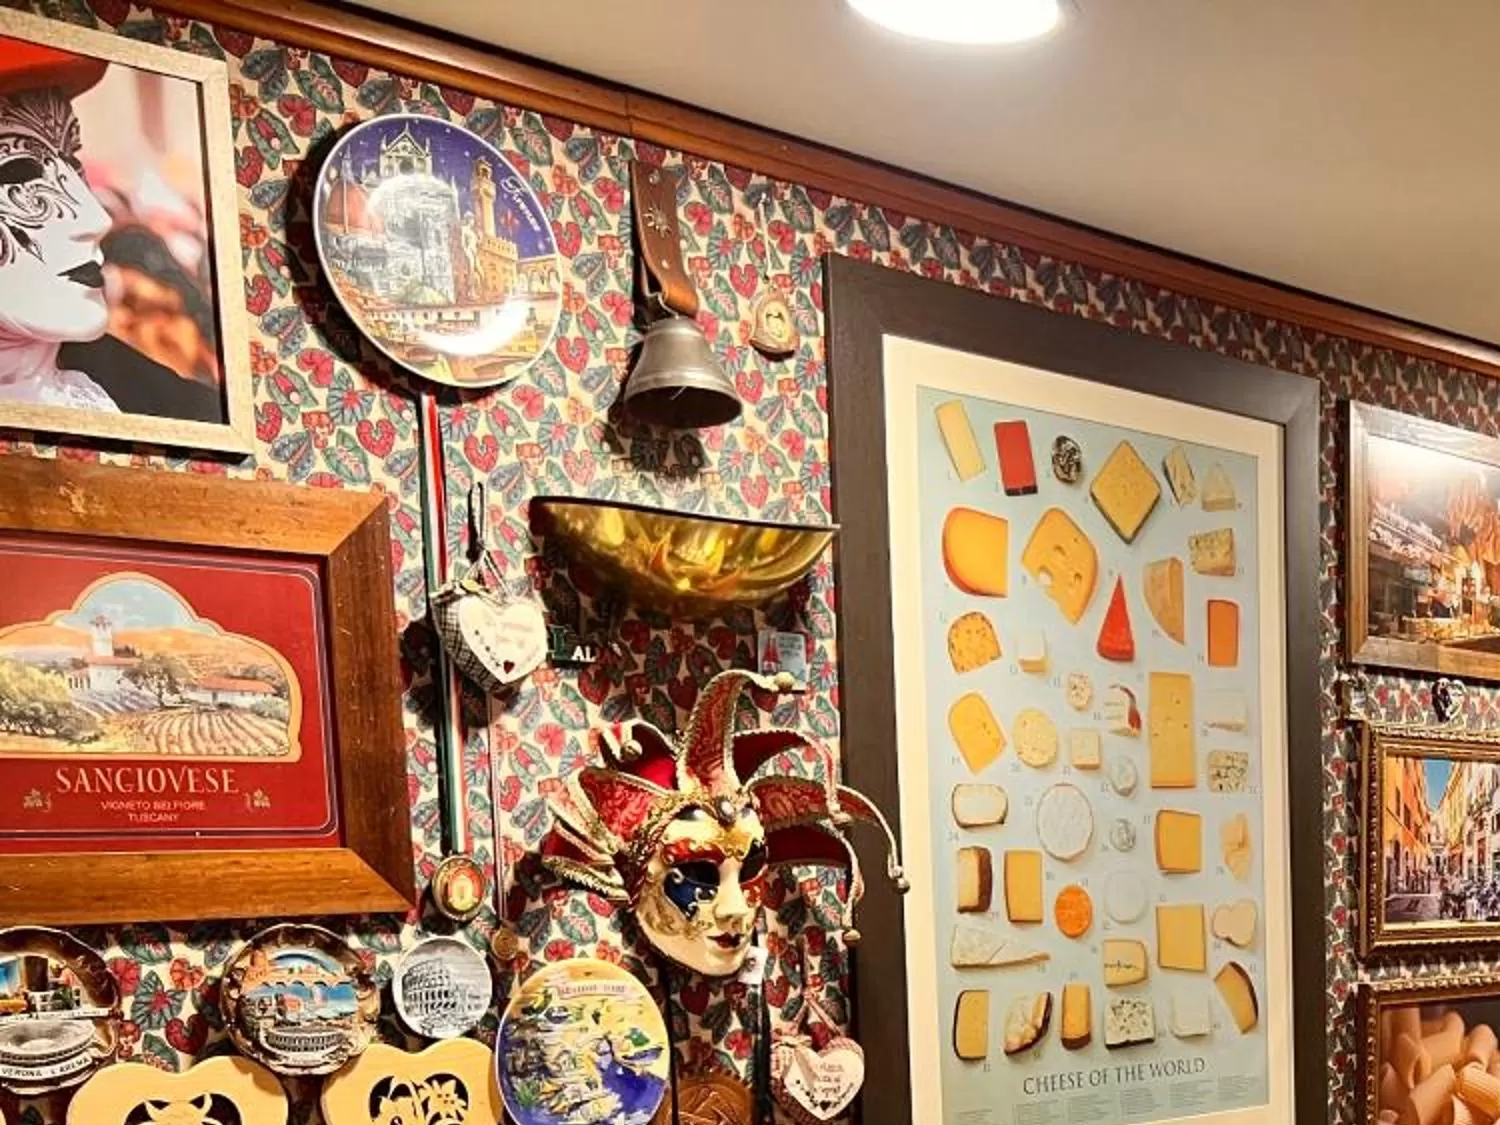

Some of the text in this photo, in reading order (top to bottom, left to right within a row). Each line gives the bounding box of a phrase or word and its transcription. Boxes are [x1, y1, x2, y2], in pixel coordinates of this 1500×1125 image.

[56, 766, 239, 794] SANGIOVESE
[101, 801, 151, 811] VIGNETO
[128, 813, 180, 823] TUSCANY
[1023, 1057, 1206, 1096] CHEESE OF THE WORLD
